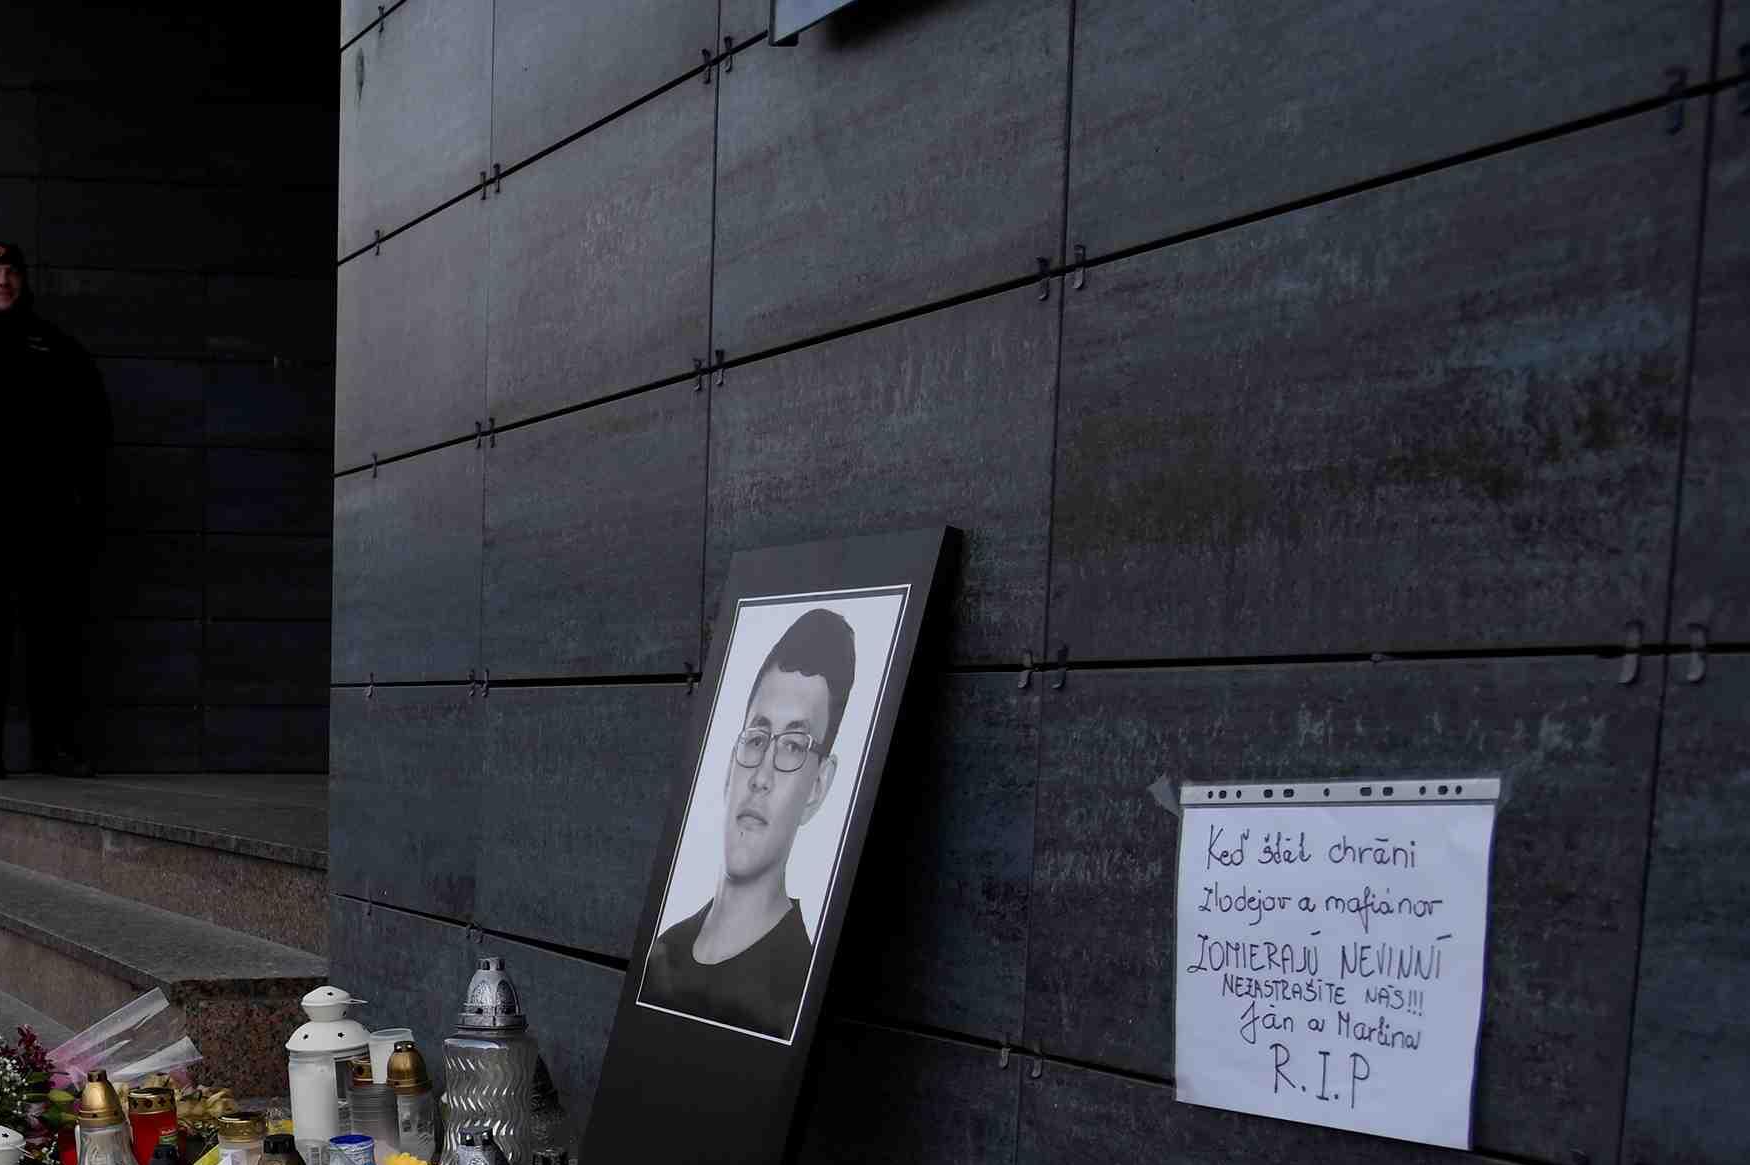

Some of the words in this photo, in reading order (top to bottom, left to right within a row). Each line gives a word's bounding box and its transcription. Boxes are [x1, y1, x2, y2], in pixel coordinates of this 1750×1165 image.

[1207, 824, 1250, 870] Keď
[1298, 895, 1317, 913] a
[1186, 930, 1322, 977] ZOMIERAJÚ
[1340, 934, 1453, 980] NEVINNÍ
[1240, 1001, 1294, 1045] Ján
[1307, 1018, 1325, 1033] a
